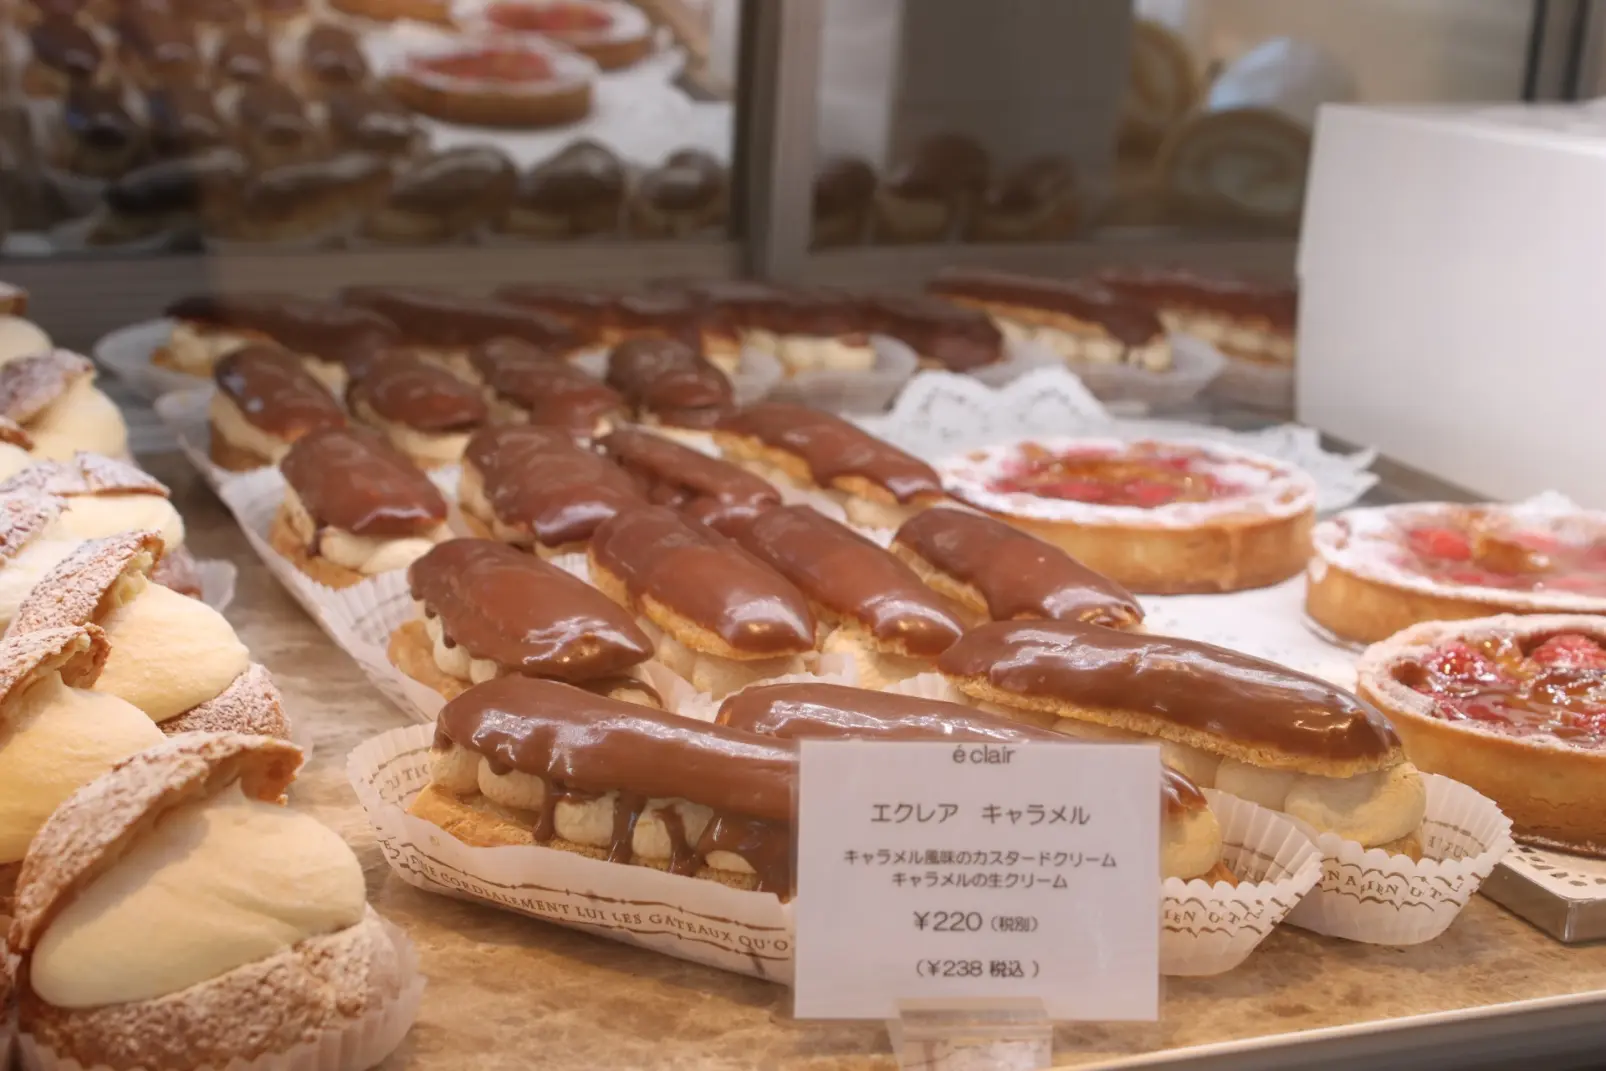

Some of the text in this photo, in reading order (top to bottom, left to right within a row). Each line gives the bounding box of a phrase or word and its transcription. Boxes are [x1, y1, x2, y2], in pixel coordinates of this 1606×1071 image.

[870, 802, 1091, 826] エクレア キャラメル
[843, 848, 1118, 869] キャラメル風味のカスタードクリーム
[891, 871, 1068, 890] キャラメルの生クリーム
[440, 872, 570, 914] CORDIALEMENT
[612, 911, 643, 925] LES
[912, 910, 984, 933] ¥220
